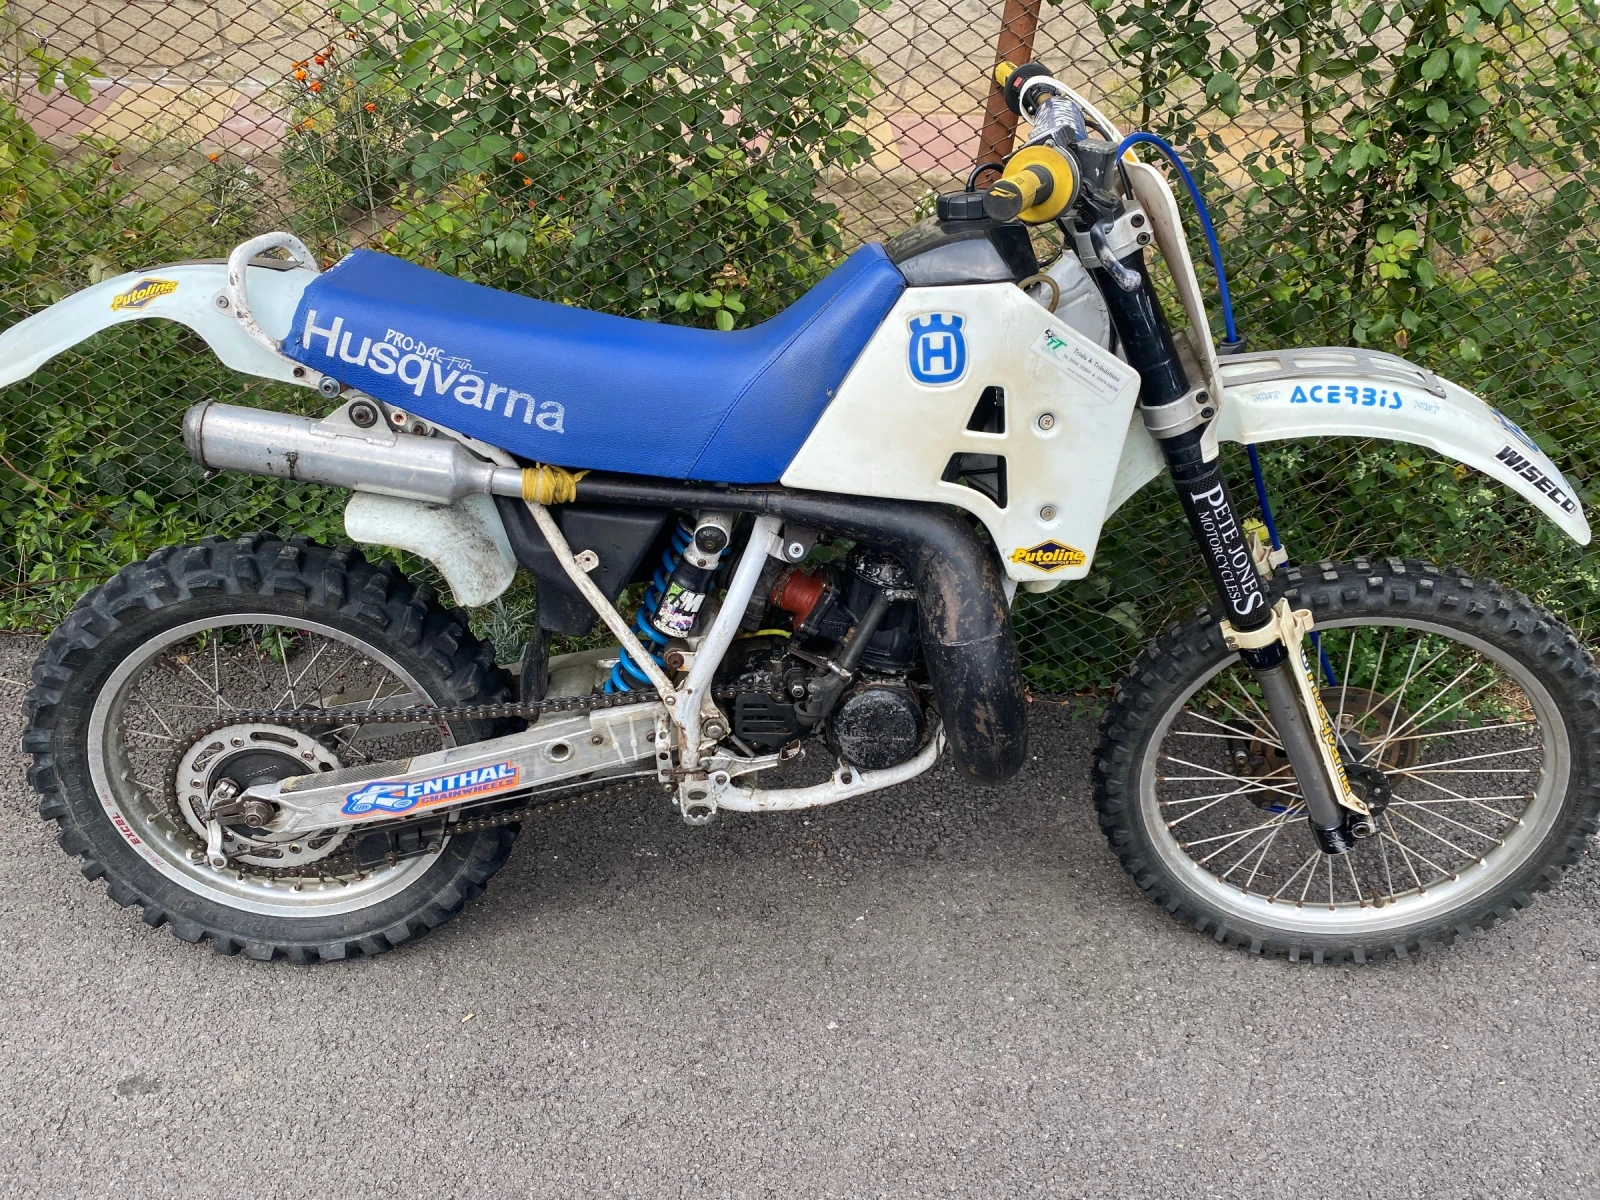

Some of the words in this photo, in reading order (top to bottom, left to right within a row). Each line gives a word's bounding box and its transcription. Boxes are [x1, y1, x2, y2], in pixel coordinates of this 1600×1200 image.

[112, 281, 177, 312] Putoline
[922, 335, 952, 371] H
[1073, 348, 1088, 361] Trials
[1094, 361, 1121, 383] Tribulations
[303, 309, 566, 434] Husqvarna
[1495, 445, 1578, 515] WISECO
[1012, 548, 1085, 563] Putoline
[1190, 480, 1240, 544] PETE
[1228, 544, 1265, 615] JONES
[1198, 510, 1241, 599] MOTORCYCLES
[421, 778, 514, 804] CHAINWHEELS
[112, 812, 142, 845] EXCEL
